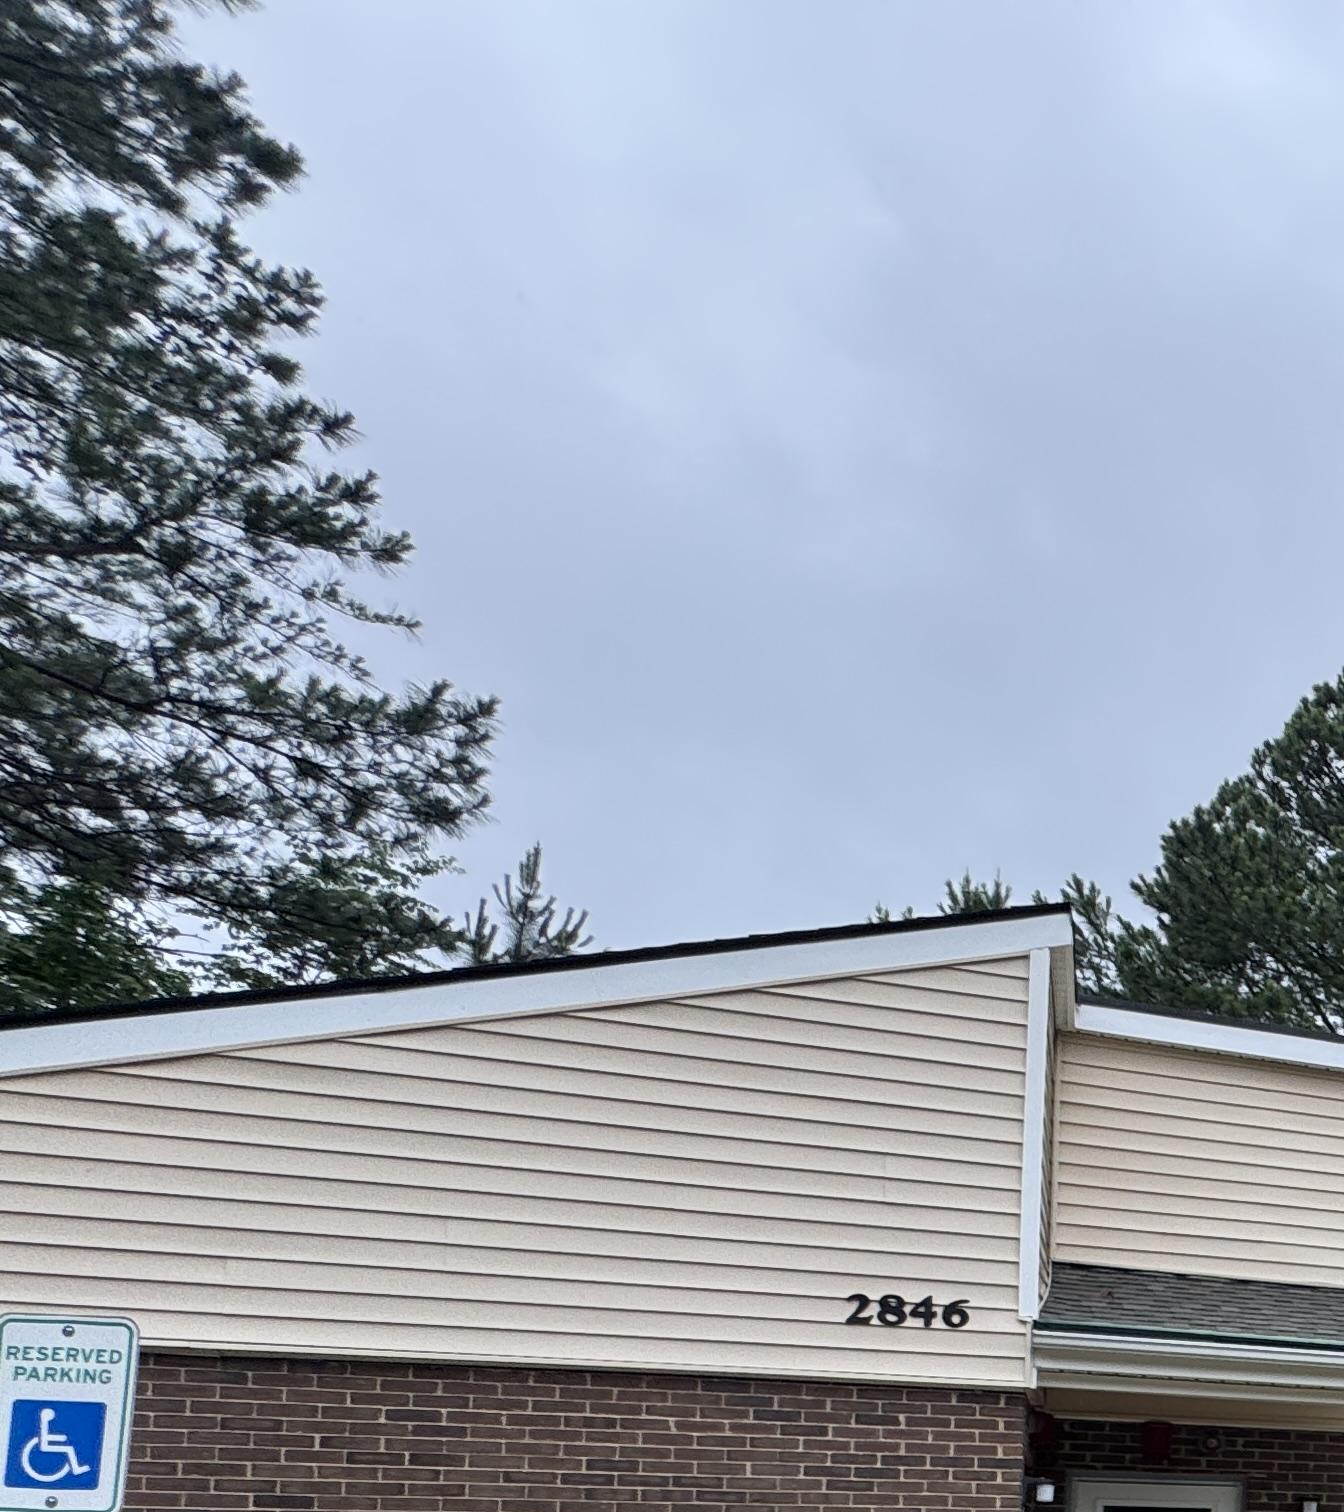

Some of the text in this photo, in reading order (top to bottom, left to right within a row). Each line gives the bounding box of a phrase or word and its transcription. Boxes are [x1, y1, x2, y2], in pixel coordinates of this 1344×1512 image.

[845, 1293, 971, 1328] 2846
[5, 1345, 123, 1365] RESERVED
[12, 1366, 112, 1385] PARKING
